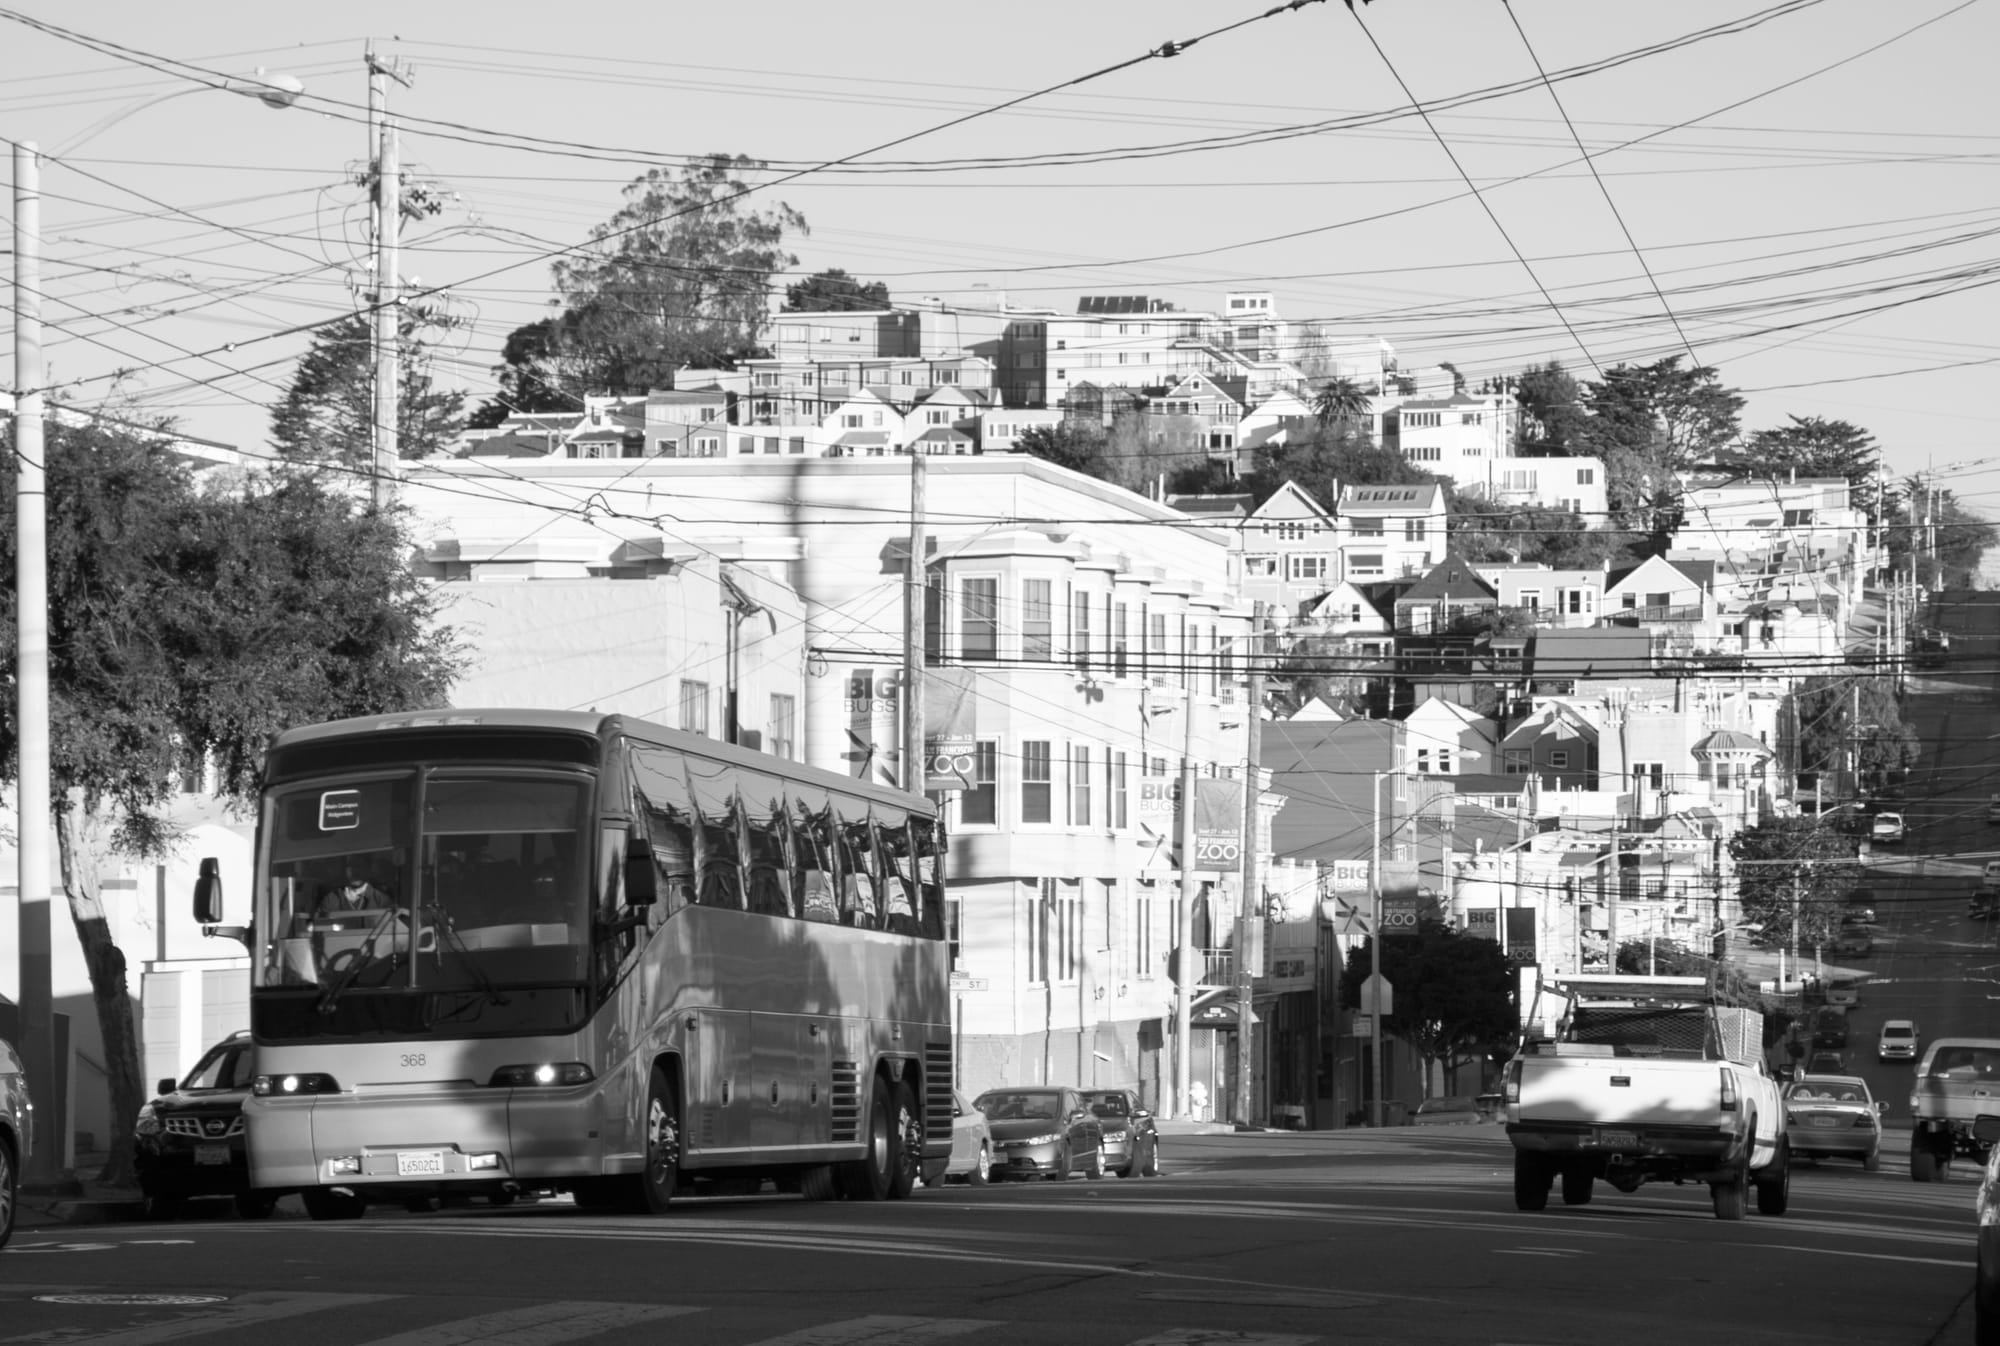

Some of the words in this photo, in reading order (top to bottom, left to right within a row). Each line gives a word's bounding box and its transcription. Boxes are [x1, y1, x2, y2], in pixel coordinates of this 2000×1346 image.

[844, 677, 897, 699] BIG
[844, 700, 897, 713] BUGS
[936, 745, 974, 755] FRANCISCO
[924, 755, 974, 774] ZOO
[1141, 783, 1181, 800] BIG
[1141, 800, 1181, 812] BUGS
[1197, 845, 1239, 860] ZOO
[1338, 867, 1369, 879] BIG
[1384, 913, 1416, 926] ZOO
[1469, 912, 1496, 923] BIG
[1508, 950, 1535, 960] ZOO
[969, 980, 981, 989] ST
[400, 1054, 426, 1067] 368
